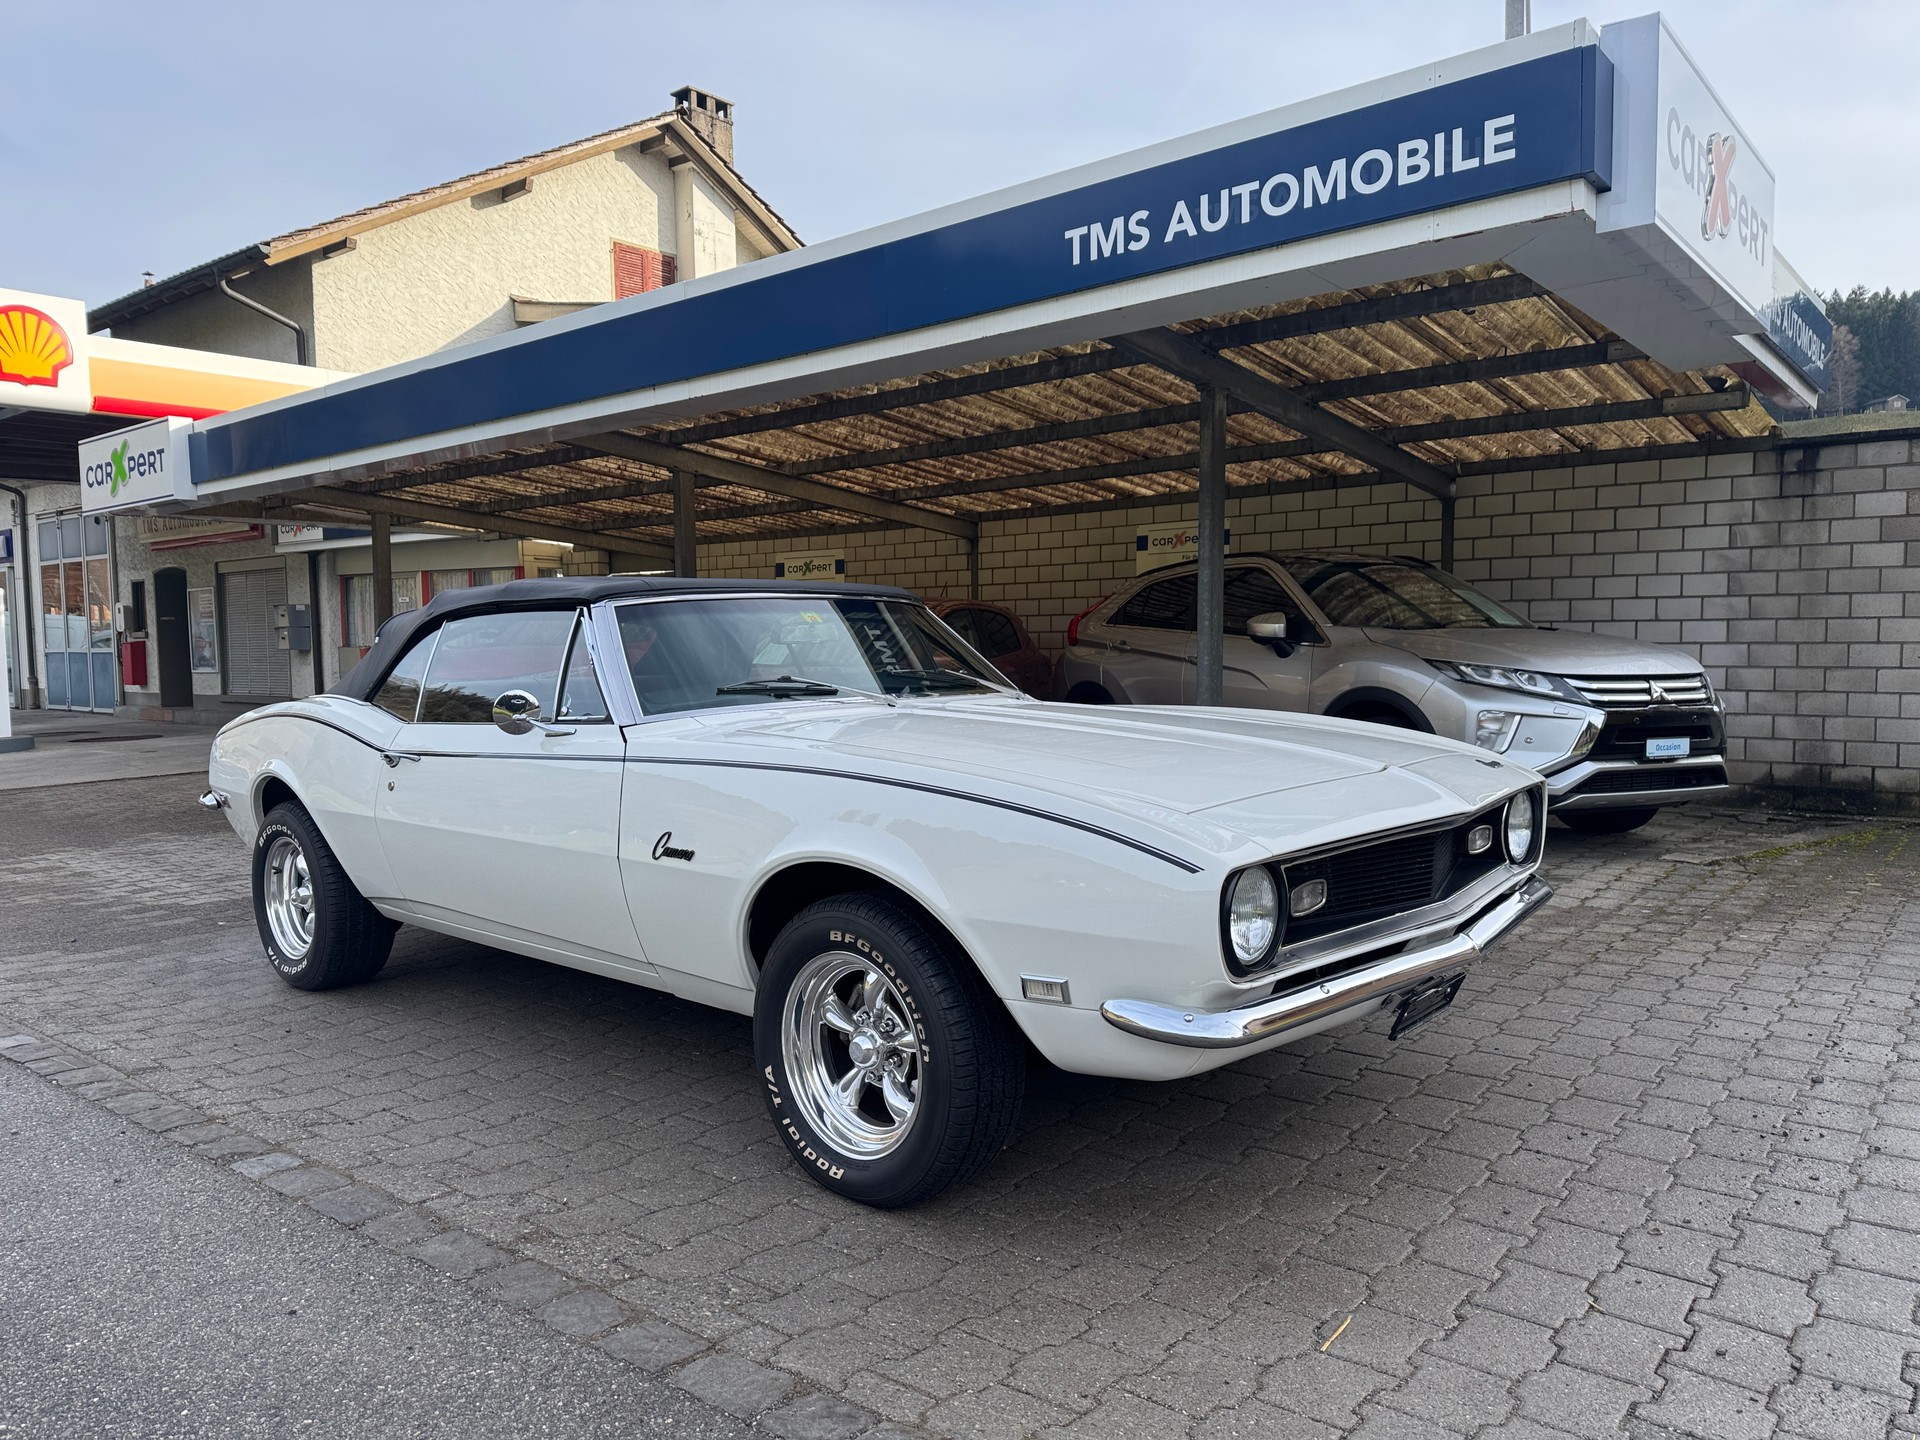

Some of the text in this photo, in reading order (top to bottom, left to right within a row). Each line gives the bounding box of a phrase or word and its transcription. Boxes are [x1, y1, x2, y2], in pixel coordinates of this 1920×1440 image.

[1064, 113, 1517, 266] TMS AUTOMOBILE
[1655, 742, 1681, 752] Occasion
[829, 929, 930, 1063] BFGoodrich
[764, 1064, 845, 1180] Radial T/A
